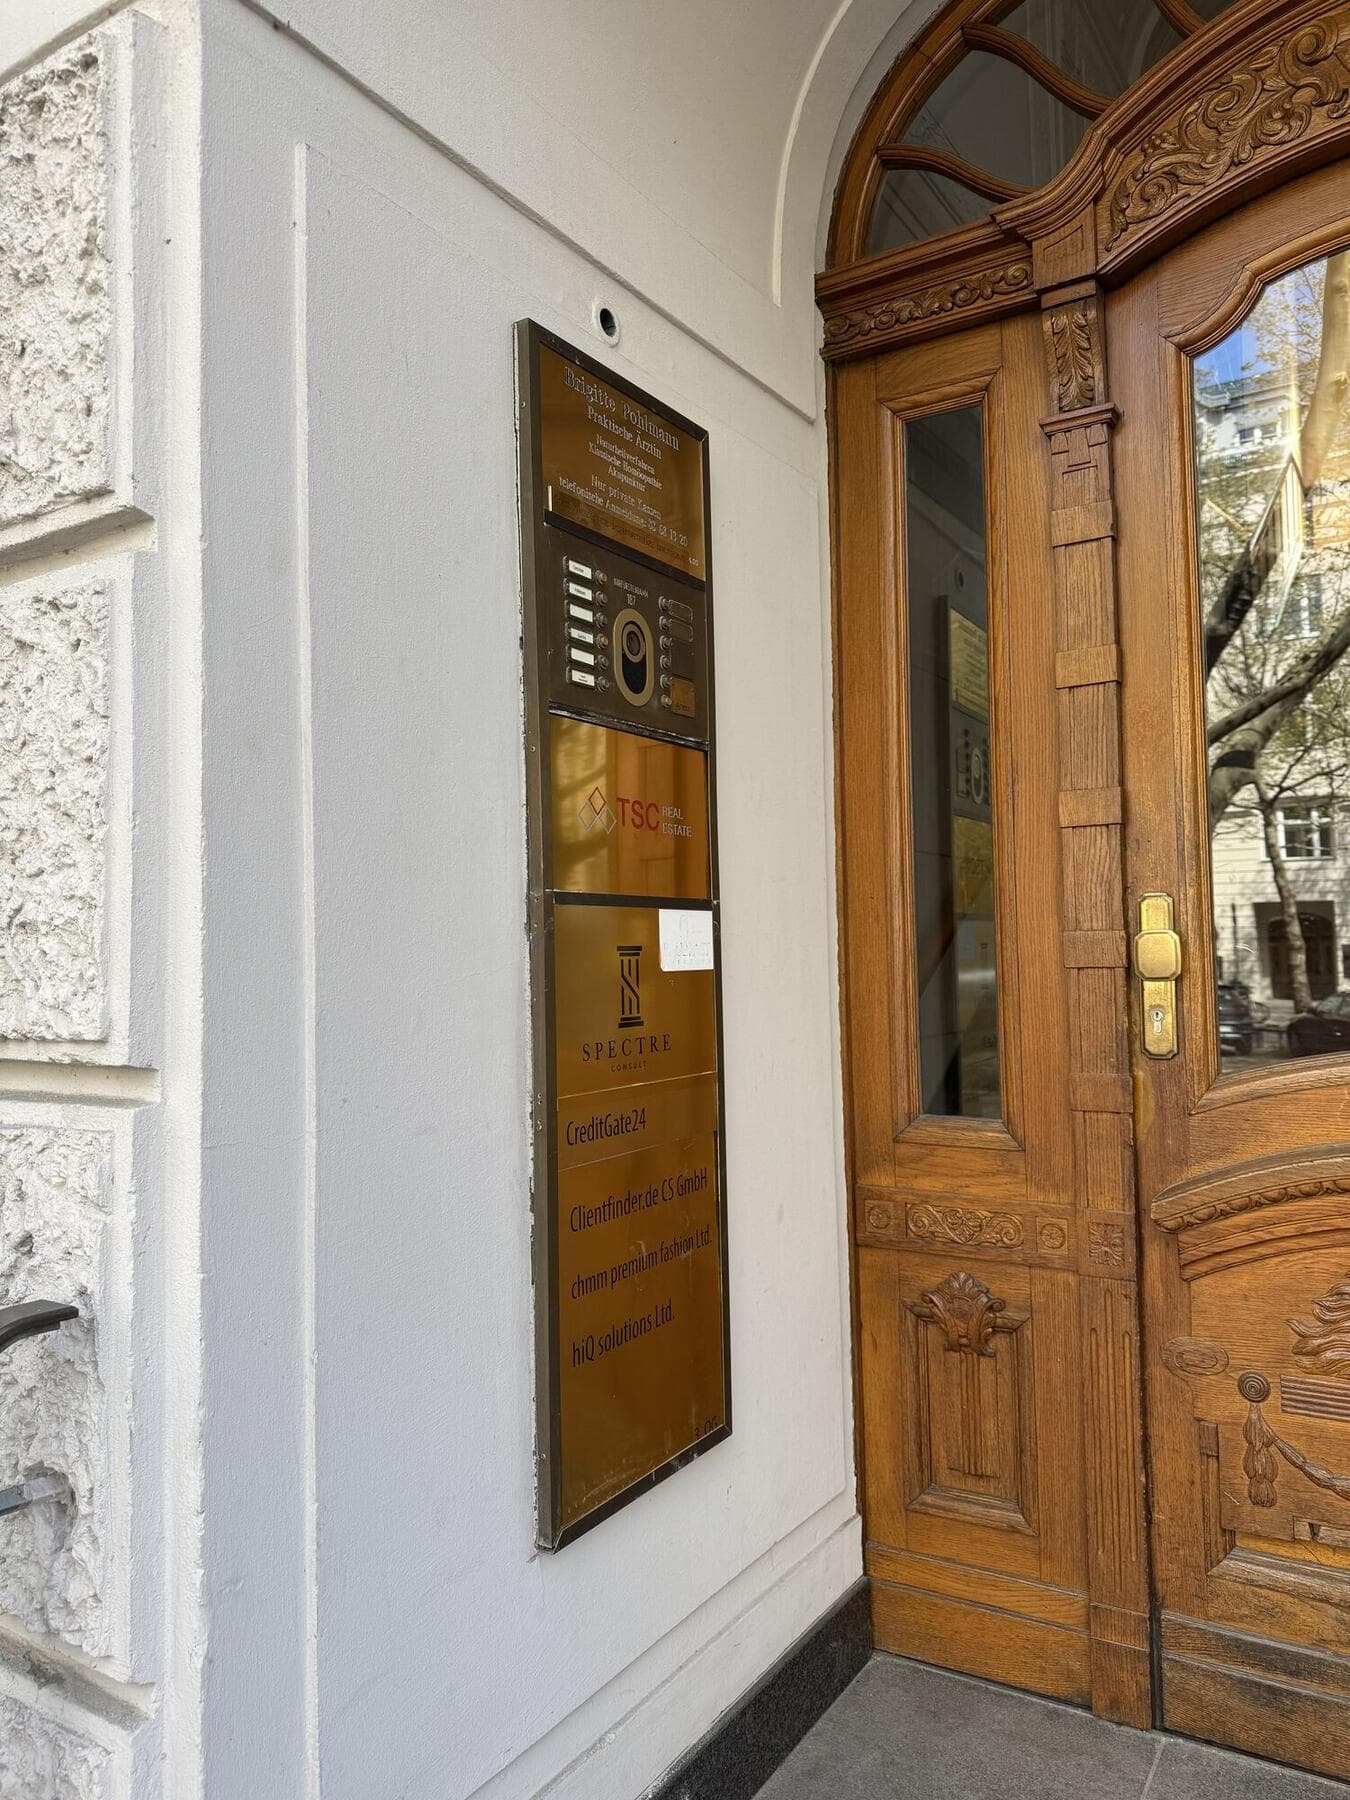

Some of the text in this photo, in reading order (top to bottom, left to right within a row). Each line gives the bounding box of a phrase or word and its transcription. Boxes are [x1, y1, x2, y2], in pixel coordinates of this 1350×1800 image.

[564, 366, 680, 450] Brigitte Pohlmann
[587, 405, 662, 459] Praktische Ärztin
[559, 476, 604, 506] telefonische
[591, 474, 606, 492] Nur
[608, 486, 635, 507] private
[607, 466, 646, 492] Akupunktur
[616, 797, 660, 832] TSC
[662, 806, 684, 820] REAL
[662, 822, 692, 838] ESTATE
[582, 1033, 672, 1062] SPECTRE
[611, 1061, 647, 1072] CONSULT
[566, 1107, 647, 1146] CreditGate24
[570, 1167, 708, 1232] Clientfinder.de CS GmbH
[571, 1224, 712, 1299] chmm premium fashion Ltd.
[572, 1298, 675, 1367] hiQ solutions Ltd.
